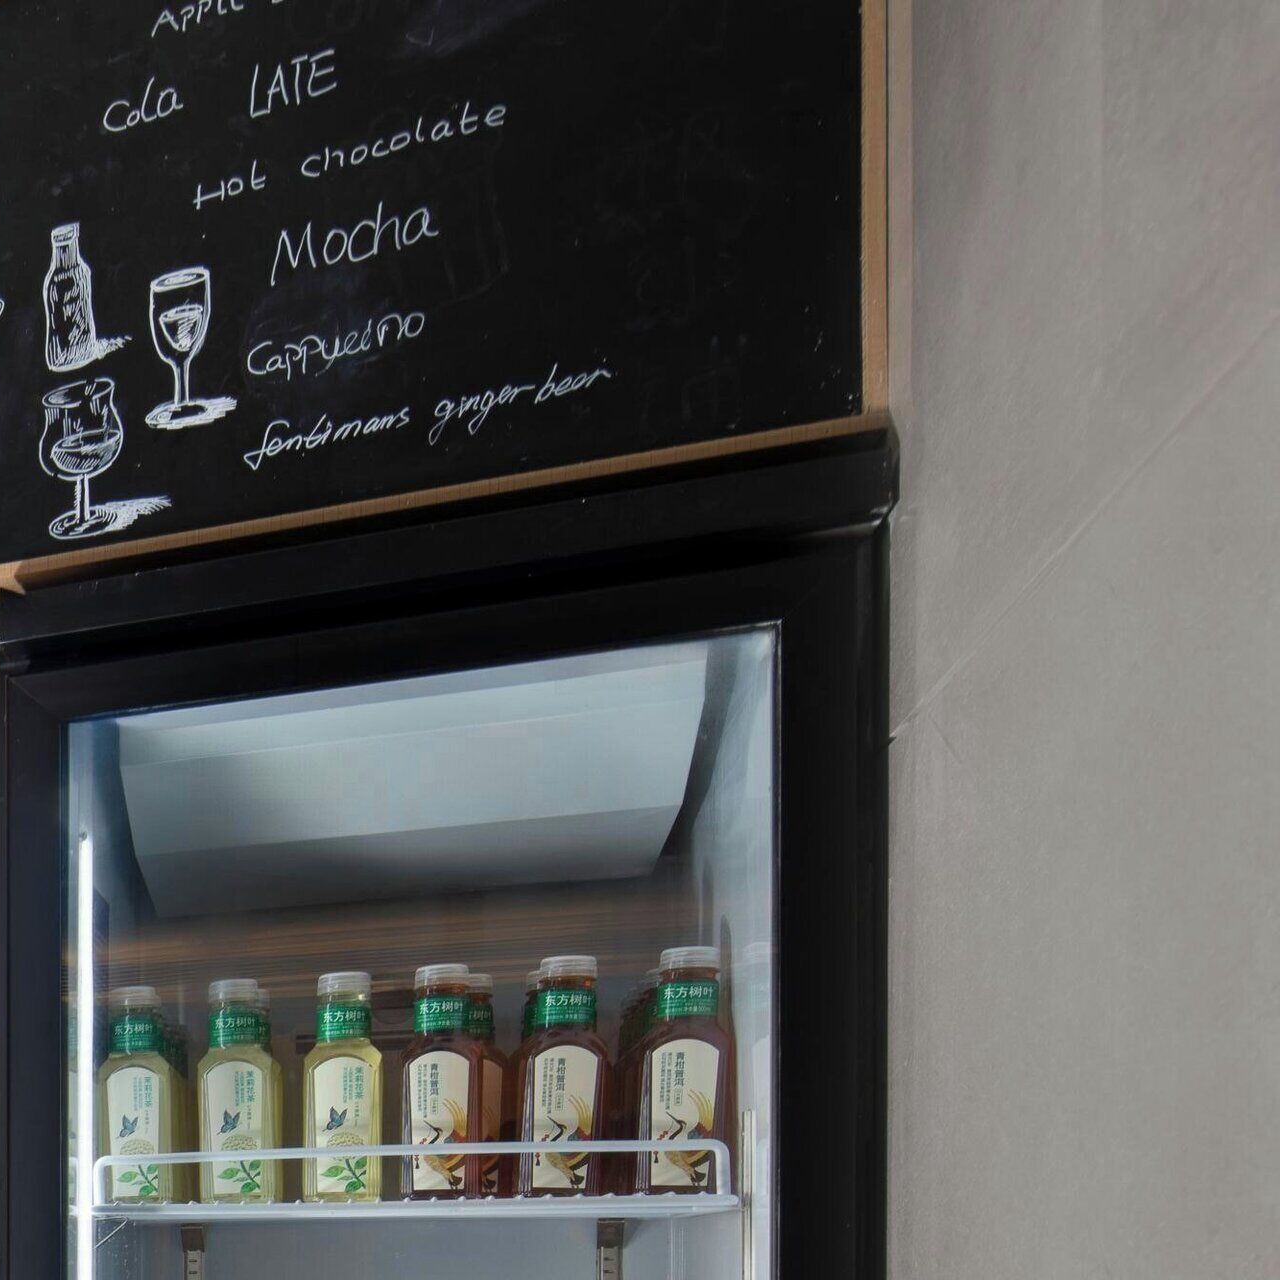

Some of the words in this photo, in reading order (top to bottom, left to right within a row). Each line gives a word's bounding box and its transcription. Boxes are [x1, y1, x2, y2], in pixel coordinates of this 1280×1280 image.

[249, 48, 338, 118] LATE
[102, 77, 183, 133] Cola
[301, 101, 507, 180] chocolate
[270, 201, 439, 288] Mocha
[545, 993, 592, 1007] 东方树叶
[663, 986, 713, 1000] 东方树叶
[419, 1000, 463, 1015] 东方树叶
[215, 1016, 255, 1029] 东方树叶
[323, 1010, 365, 1024] 东方树叶
